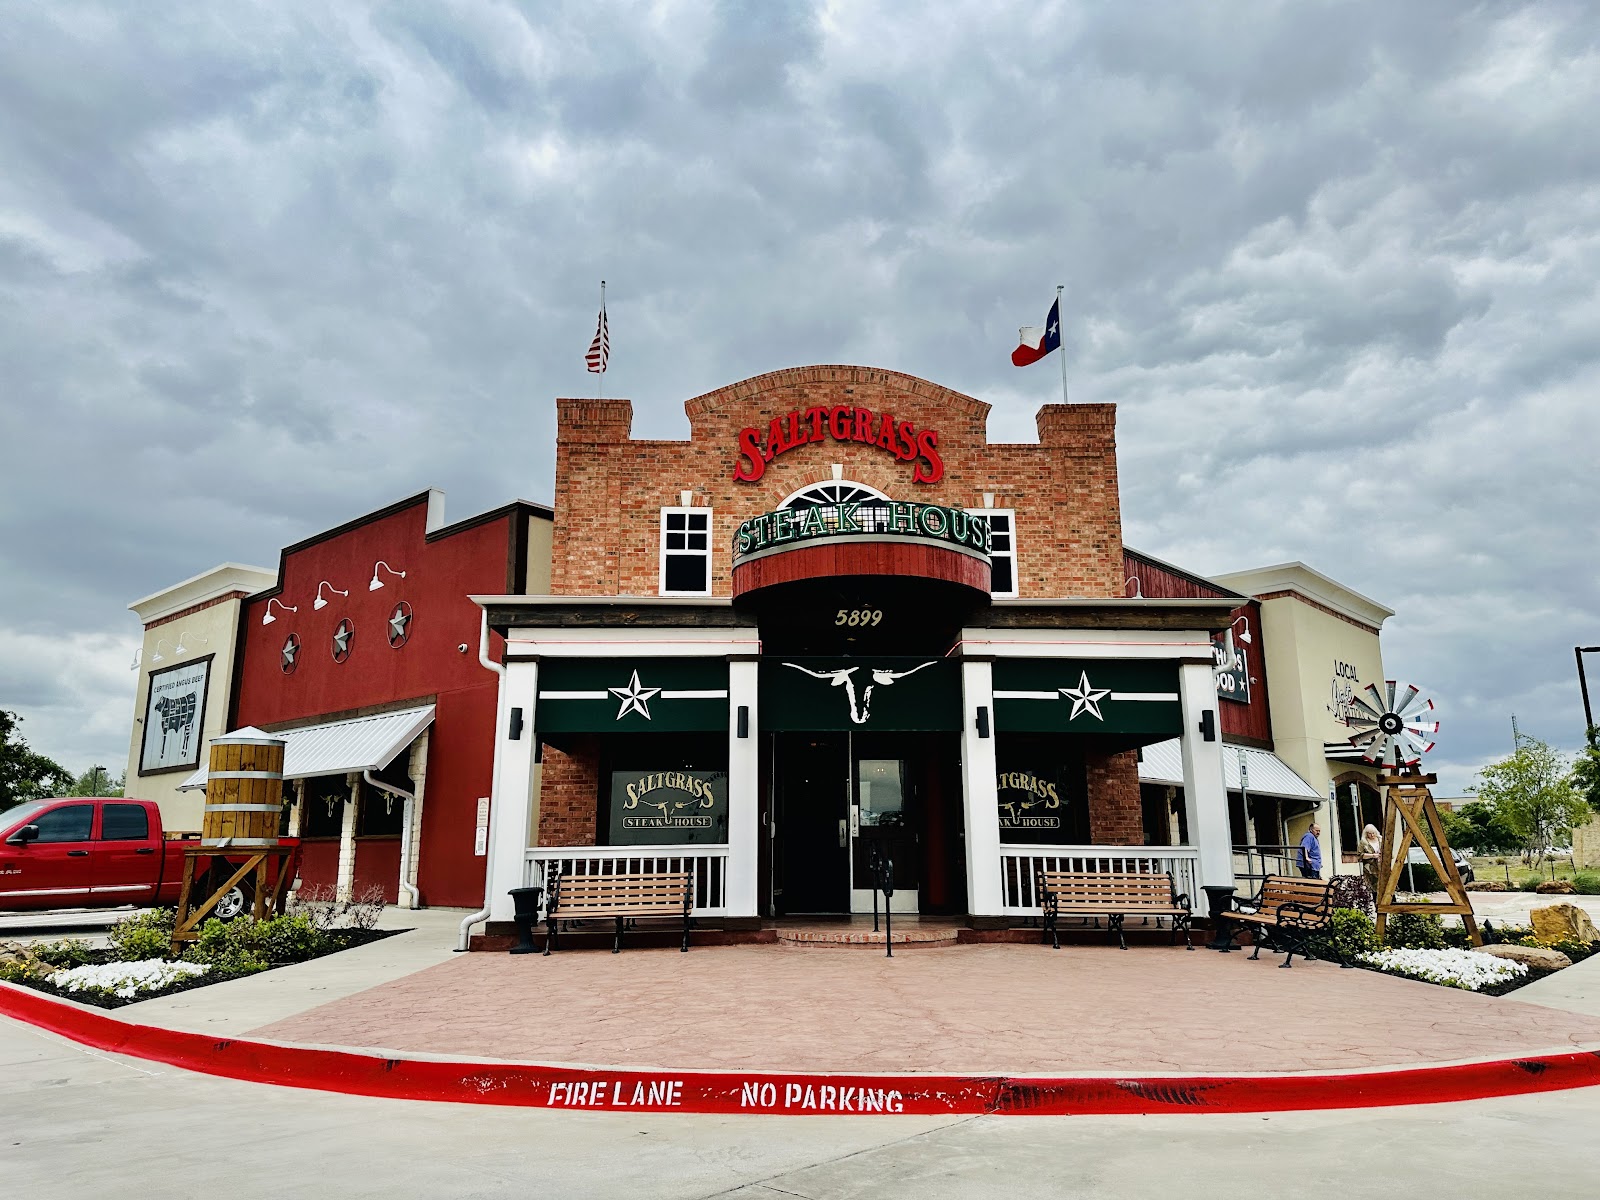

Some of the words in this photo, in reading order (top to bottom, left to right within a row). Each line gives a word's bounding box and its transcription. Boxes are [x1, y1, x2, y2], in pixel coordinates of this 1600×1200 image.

[733, 405, 944, 484] SALTGRASS
[739, 502, 862, 553] STEAK
[834, 609, 883, 627] 5899
[1334, 659, 1360, 683] LOCAL
[153, 682, 175, 693] CERTIFIED
[176, 678, 190, 687] ANGUS
[192, 674, 204, 684] BEEF
[623, 771, 714, 809] SALTGRASS
[627, 818, 662, 826] STEAK
[675, 818, 708, 826] HOUSE
[1022, 818, 1056, 826] HOUSE
[547, 1081, 607, 1106] FIRE
[612, 1081, 684, 1107] LANE
[740, 1082, 776, 1107] NO
[784, 1083, 904, 1113] PARKING
